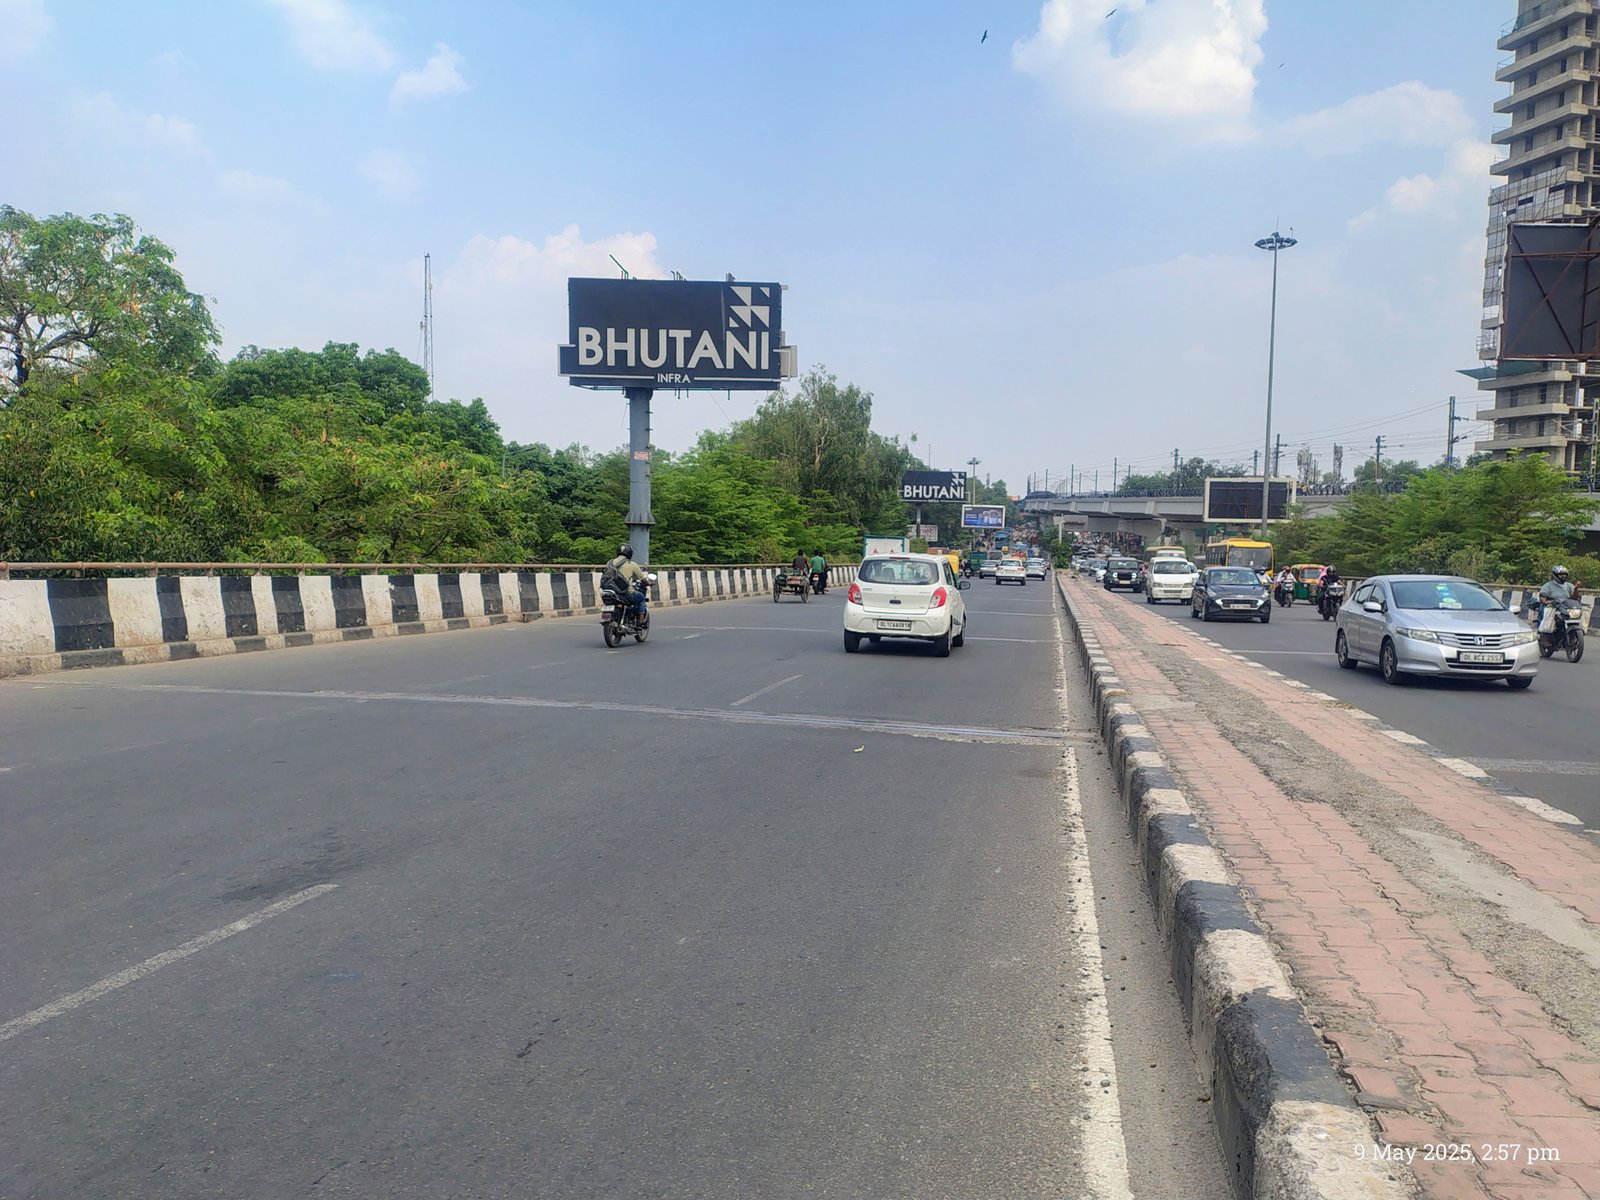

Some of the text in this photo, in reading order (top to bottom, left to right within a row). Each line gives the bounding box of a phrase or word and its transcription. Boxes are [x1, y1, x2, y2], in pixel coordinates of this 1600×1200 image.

[578, 327, 769, 370] BHUTANI
[657, 373, 691, 383] INFRA
[903, 485, 964, 499] BHUTANI
